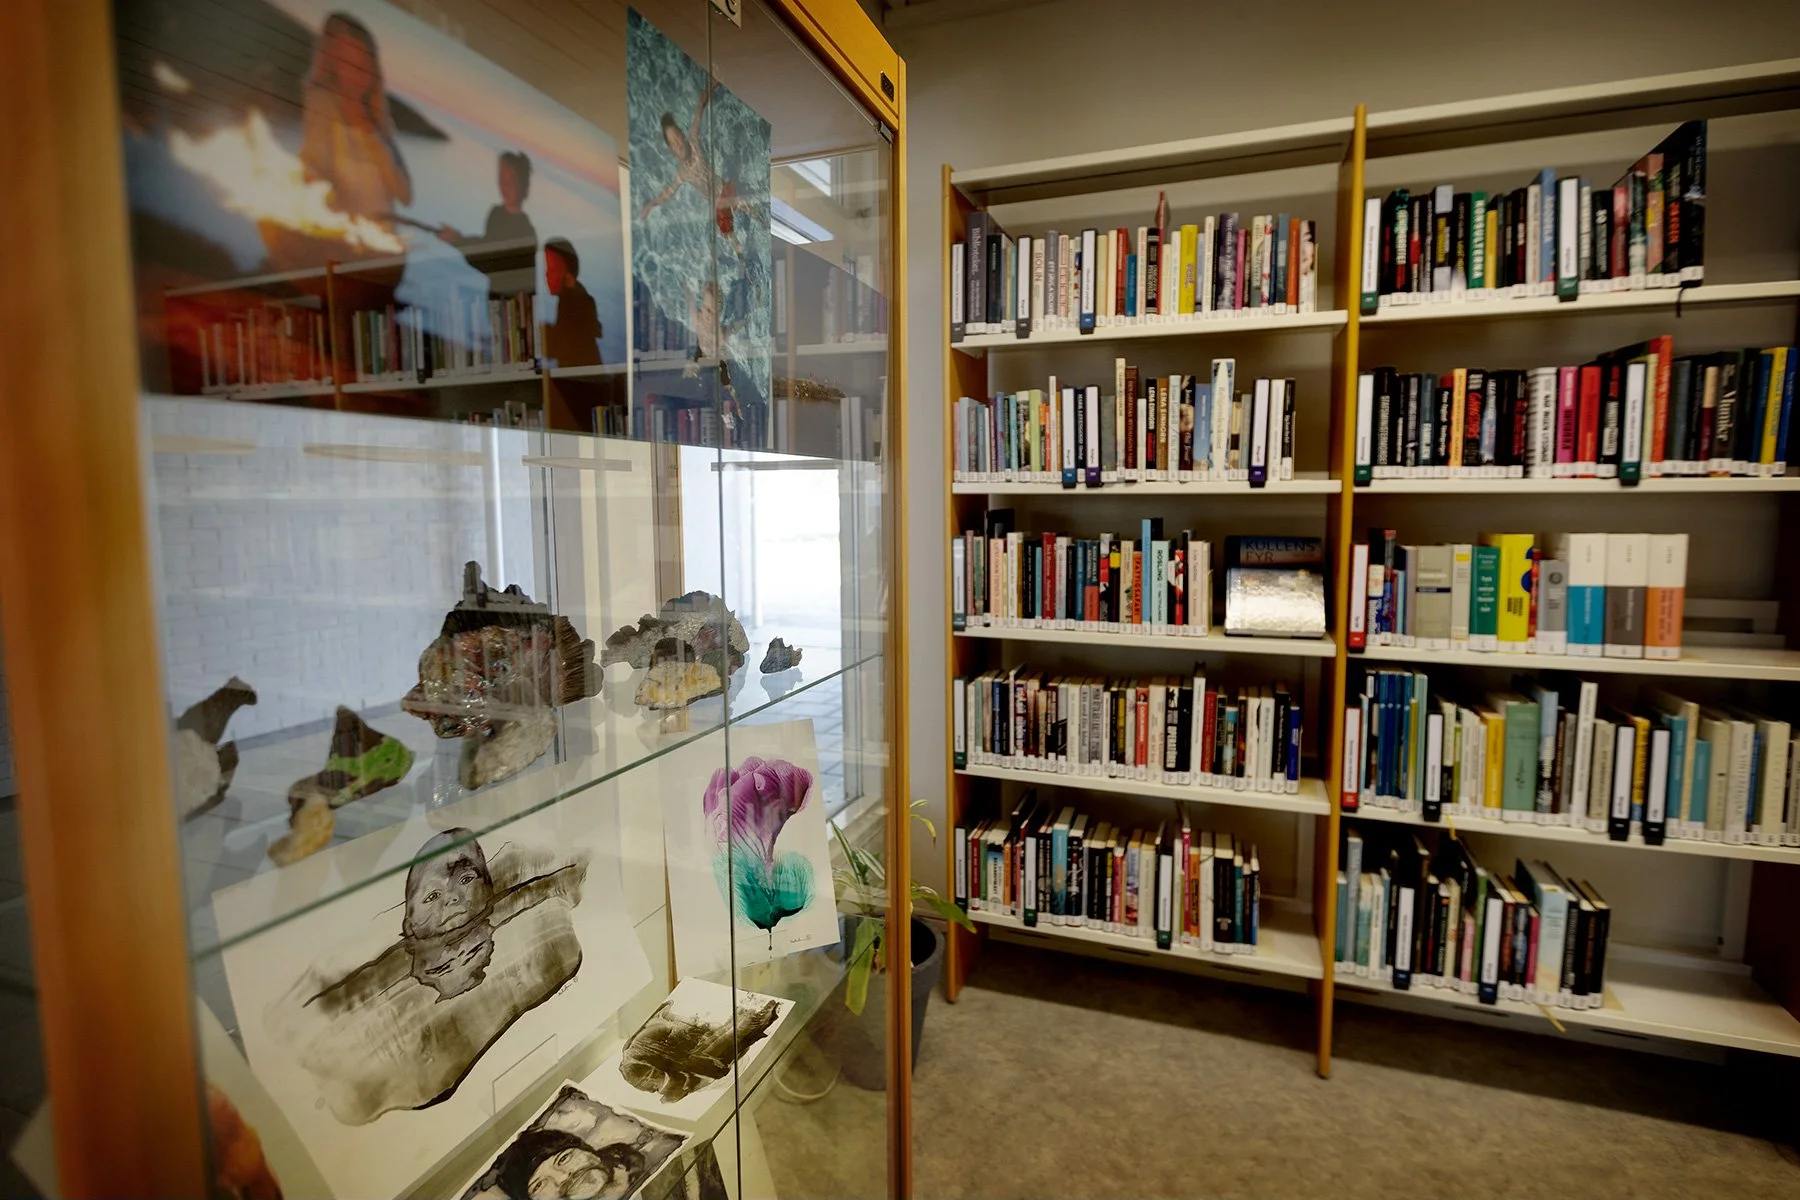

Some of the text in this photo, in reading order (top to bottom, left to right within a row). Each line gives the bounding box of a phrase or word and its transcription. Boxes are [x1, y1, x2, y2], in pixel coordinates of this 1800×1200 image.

[1472, 200, 1485, 279] KONSULTERNA
[1035, 252, 1043, 282] BOLIN
[1246, 540, 1316, 552] KULLENS
[1246, 552, 1275, 562] FYR
